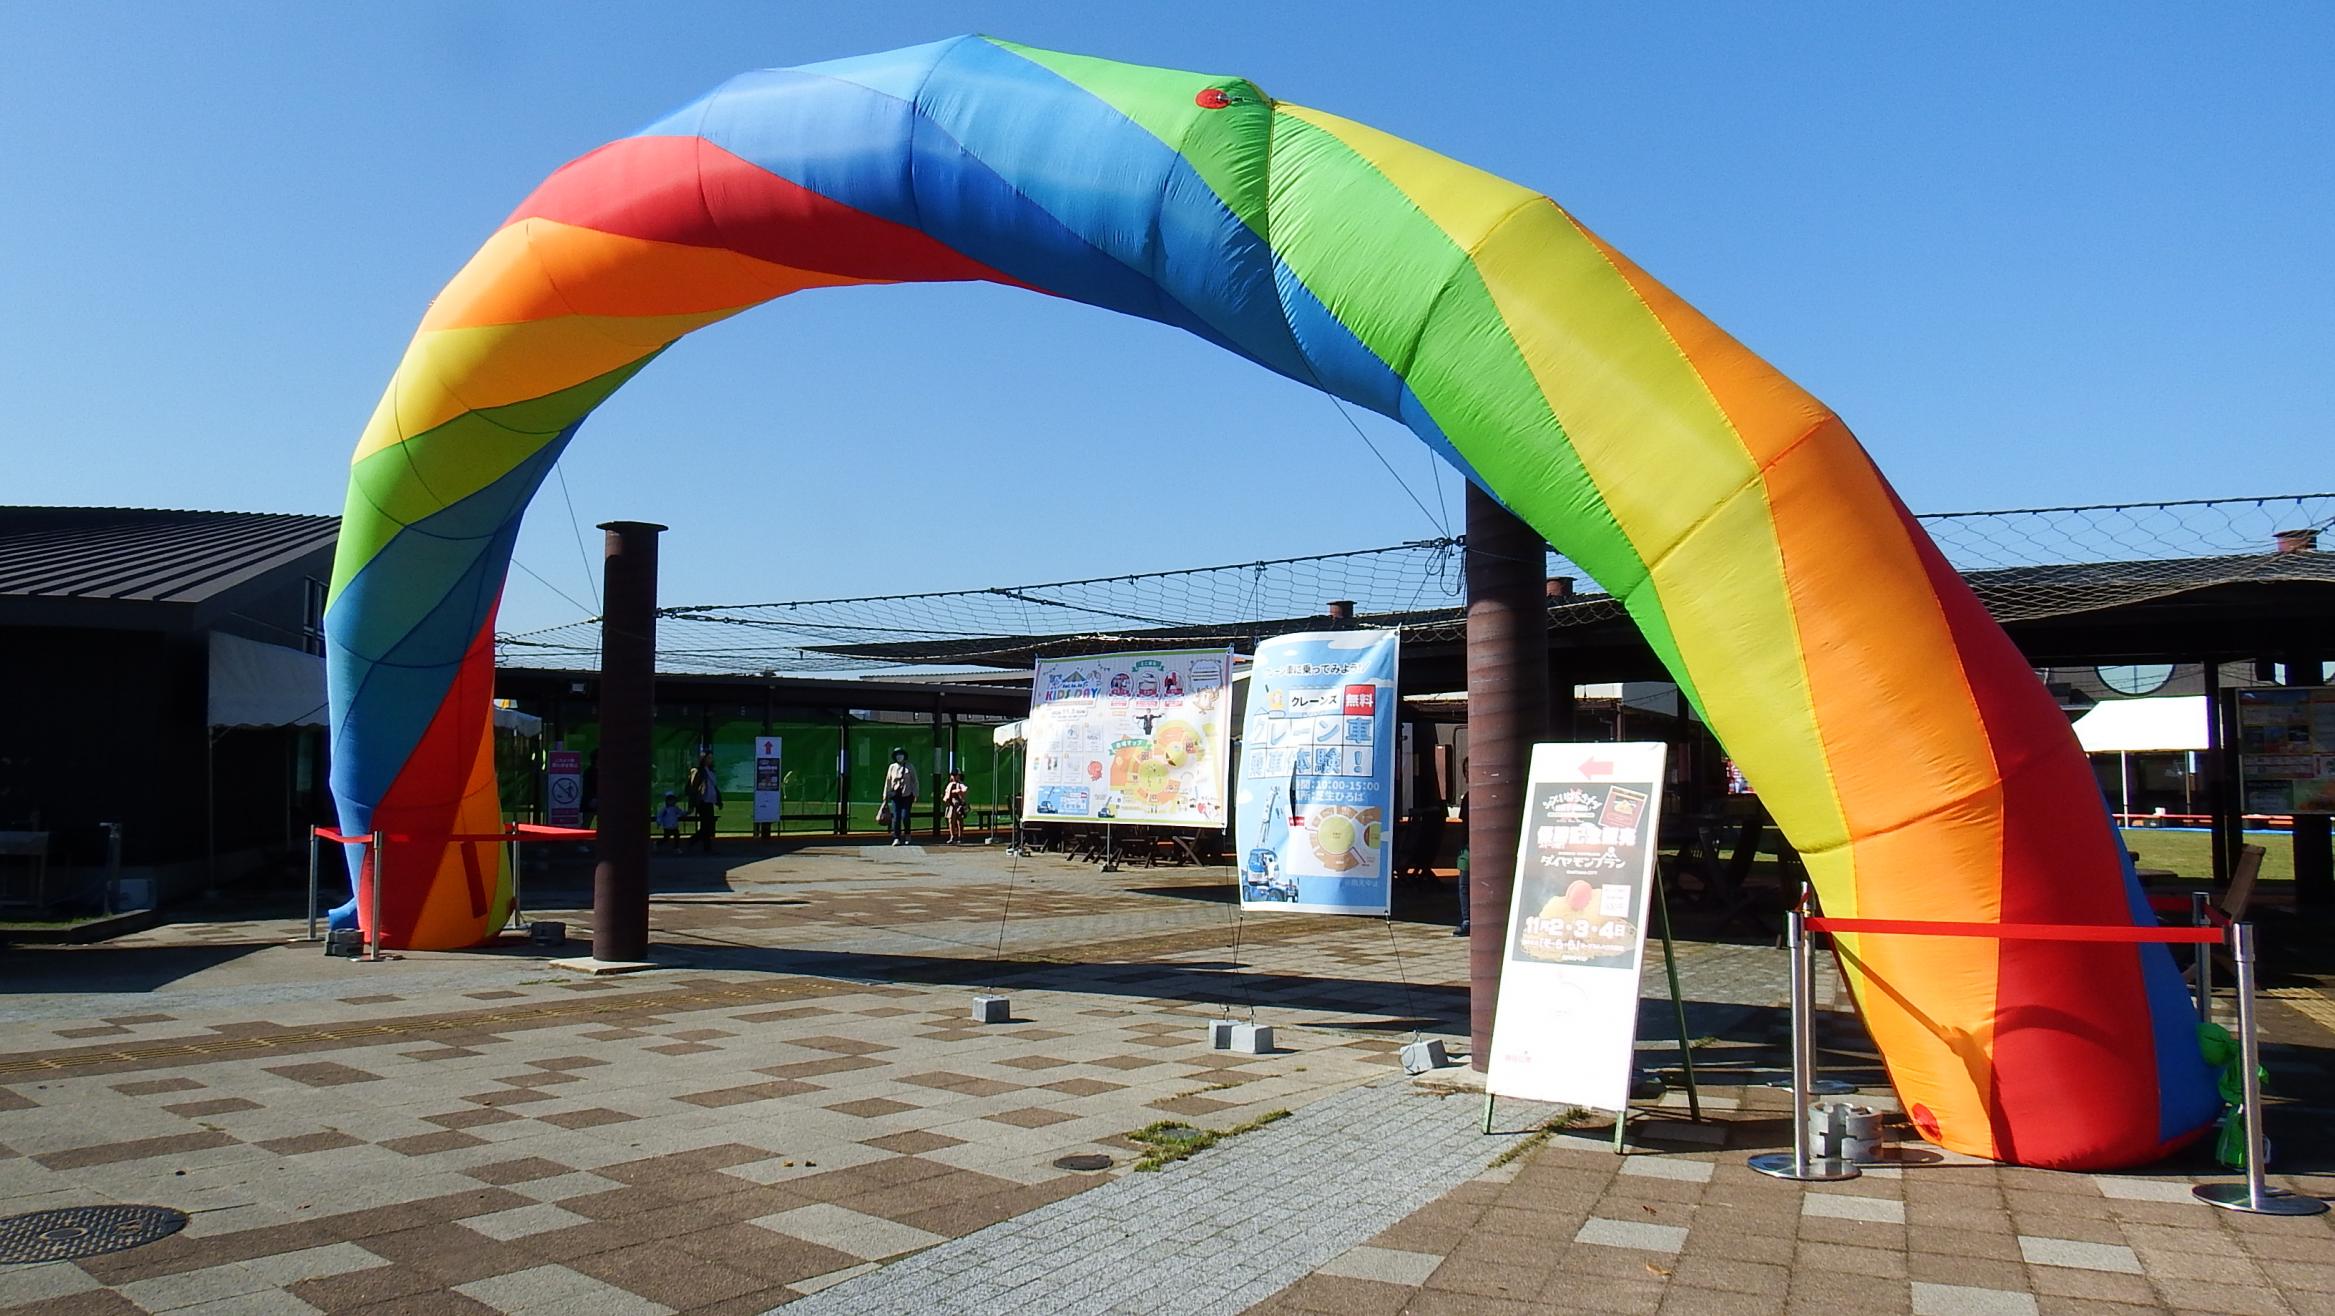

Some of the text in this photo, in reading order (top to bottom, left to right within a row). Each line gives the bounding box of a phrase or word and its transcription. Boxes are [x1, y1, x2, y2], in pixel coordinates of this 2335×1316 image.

[1046, 689, 1071, 701] KIDS
[1074, 687, 1098, 699] DAY
[1346, 693, 1374, 708] 無料
[1296, 778, 1380, 791] 間:10:00-15:00
